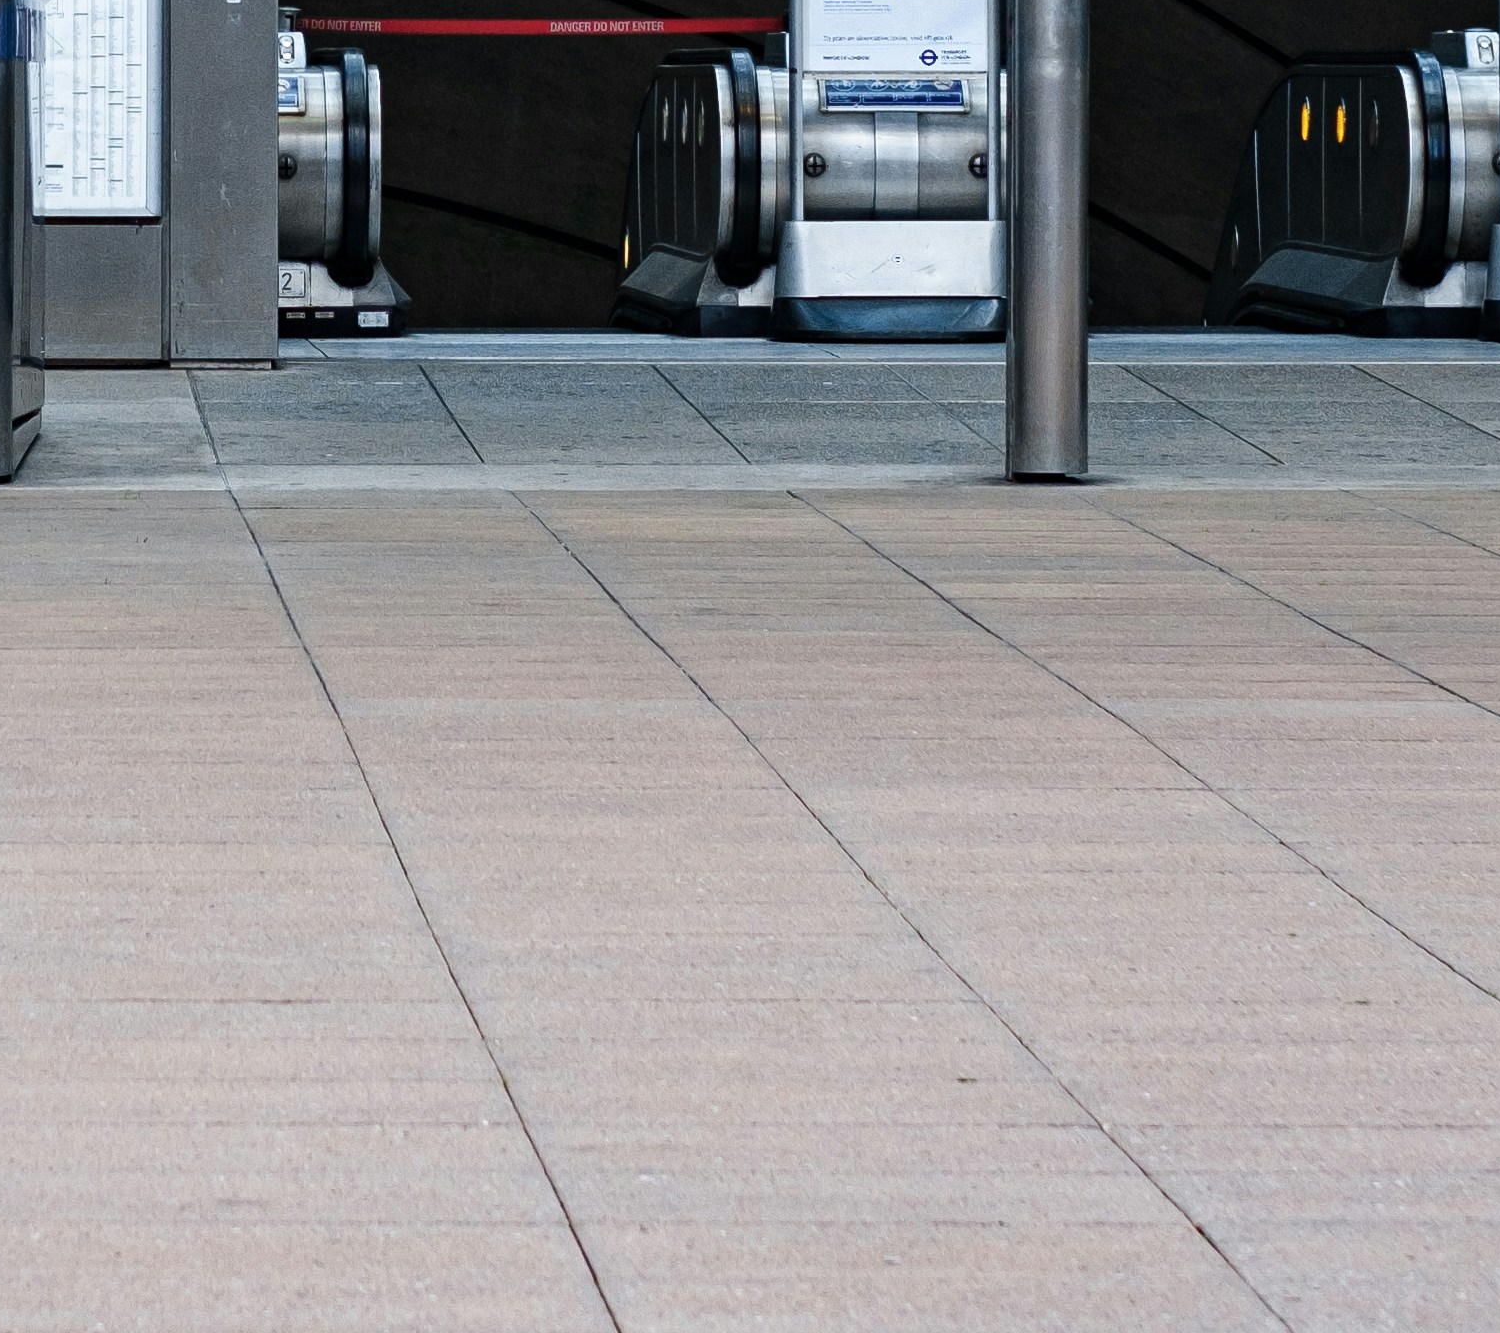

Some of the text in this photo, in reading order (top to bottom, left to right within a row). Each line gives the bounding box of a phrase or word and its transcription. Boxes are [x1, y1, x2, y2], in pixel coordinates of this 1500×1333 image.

[311, 19, 325, 30] DO
[327, 19, 348, 31] NOT
[349, 20, 381, 32] ENTER
[550, 21, 664, 32] DANGER DO NOT ENTER
